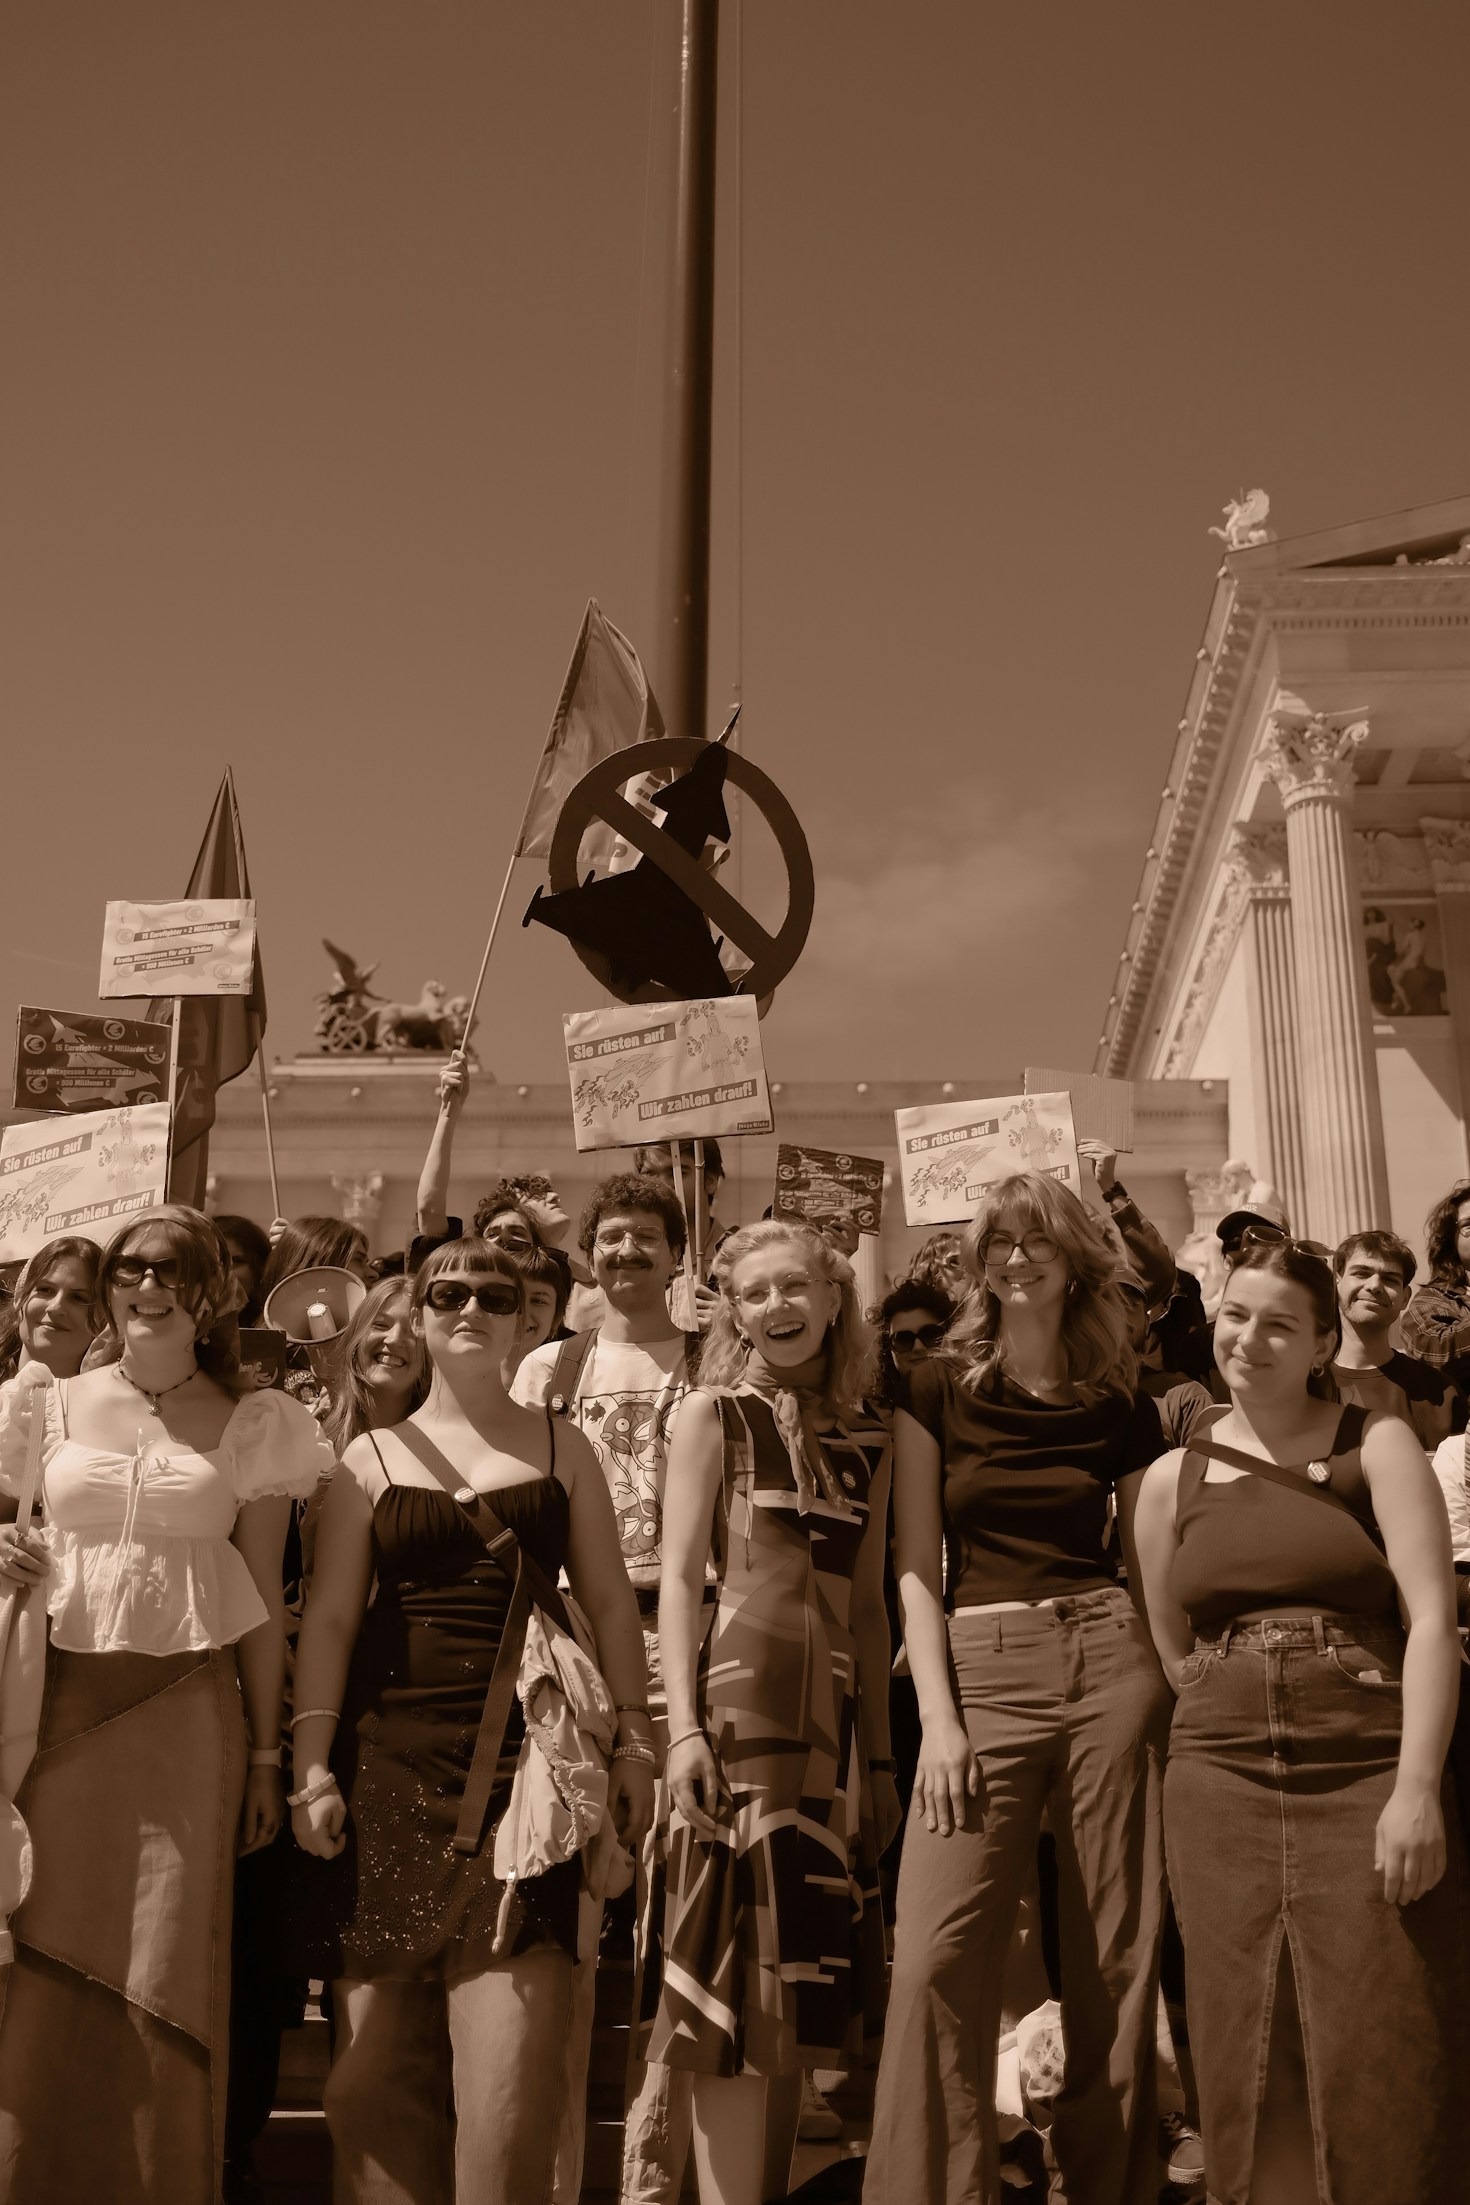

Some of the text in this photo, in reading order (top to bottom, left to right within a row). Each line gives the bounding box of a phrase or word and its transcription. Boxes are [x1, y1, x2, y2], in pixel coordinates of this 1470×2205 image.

[55, 1044, 62, 1052] 15
[64, 1044, 101, 1053] Eurofighter
[114, 1045, 148, 1053] Milliarden
[573, 1027, 665, 1060] Sie rüsten auf
[46, 1068, 86, 1076] Mittagessen
[74, 1079, 104, 1087] Millionen
[640, 1081, 753, 1119] Wir zahlen drauf!
[910, 1121, 990, 1151] Sie rüsten auf
[3, 1137, 83, 1174] Sie rüsten auf
[967, 1185, 988, 1200] Wir
[46, 1194, 150, 1232] Wir zahlen drauf!
